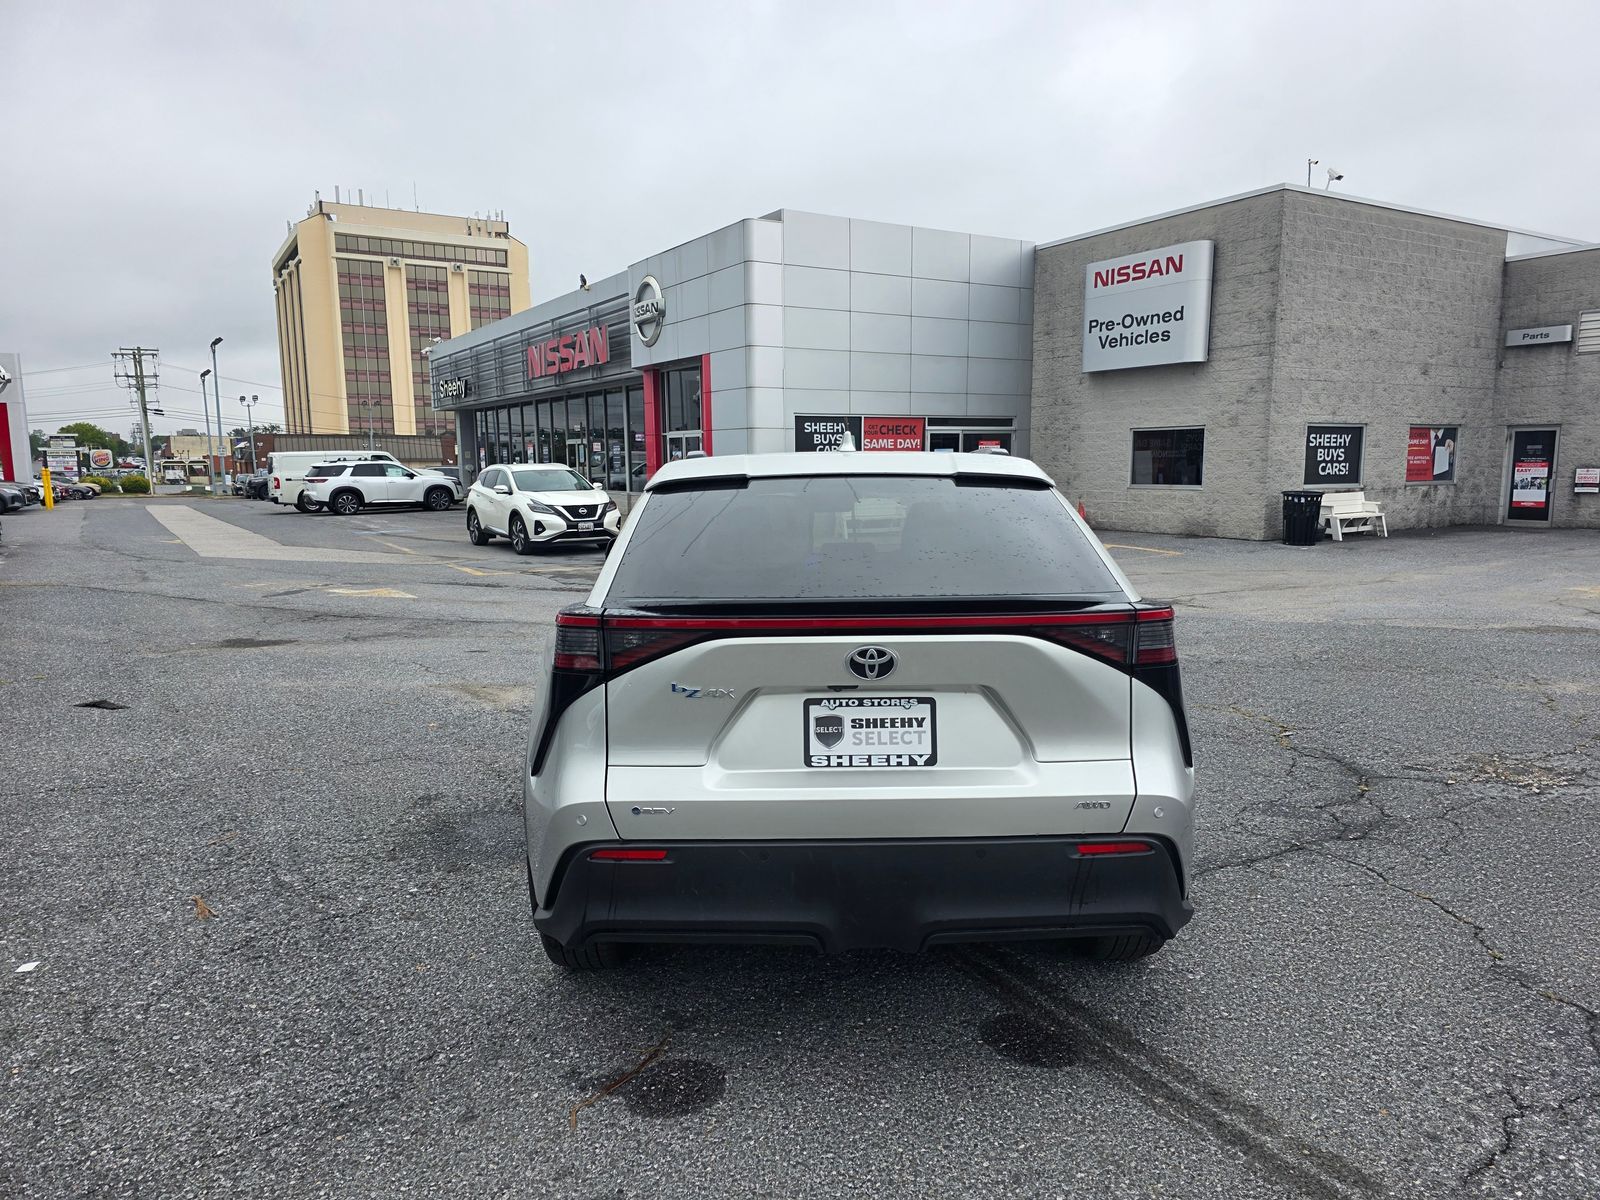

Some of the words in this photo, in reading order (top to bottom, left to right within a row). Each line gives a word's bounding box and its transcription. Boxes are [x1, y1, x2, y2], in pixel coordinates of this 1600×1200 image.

[1094, 254, 1183, 288] NISSAN
[1088, 305, 1184, 334] Pre-Owned
[1098, 329, 1171, 349] Vehicles
[1522, 332, 1550, 340] Parts
[527, 324, 610, 379] NISSAN
[439, 377, 467, 398] Sheehy
[879, 425, 917, 435] CHECK
[813, 434, 843, 444] BUYS
[864, 438, 895, 449] SAME
[897, 438, 921, 449] DAY!
[1309, 433, 1352, 447] SHEEHY
[1316, 448, 1345, 461] BUYS
[1318, 462, 1349, 475] CARS!
[820, 698, 858, 707] AUTO
[863, 698, 918, 707] STORES
[850, 717, 926, 729] SHEEHY
[851, 730, 926, 746] SELECT
[811, 754, 931, 767] SHEEHY
